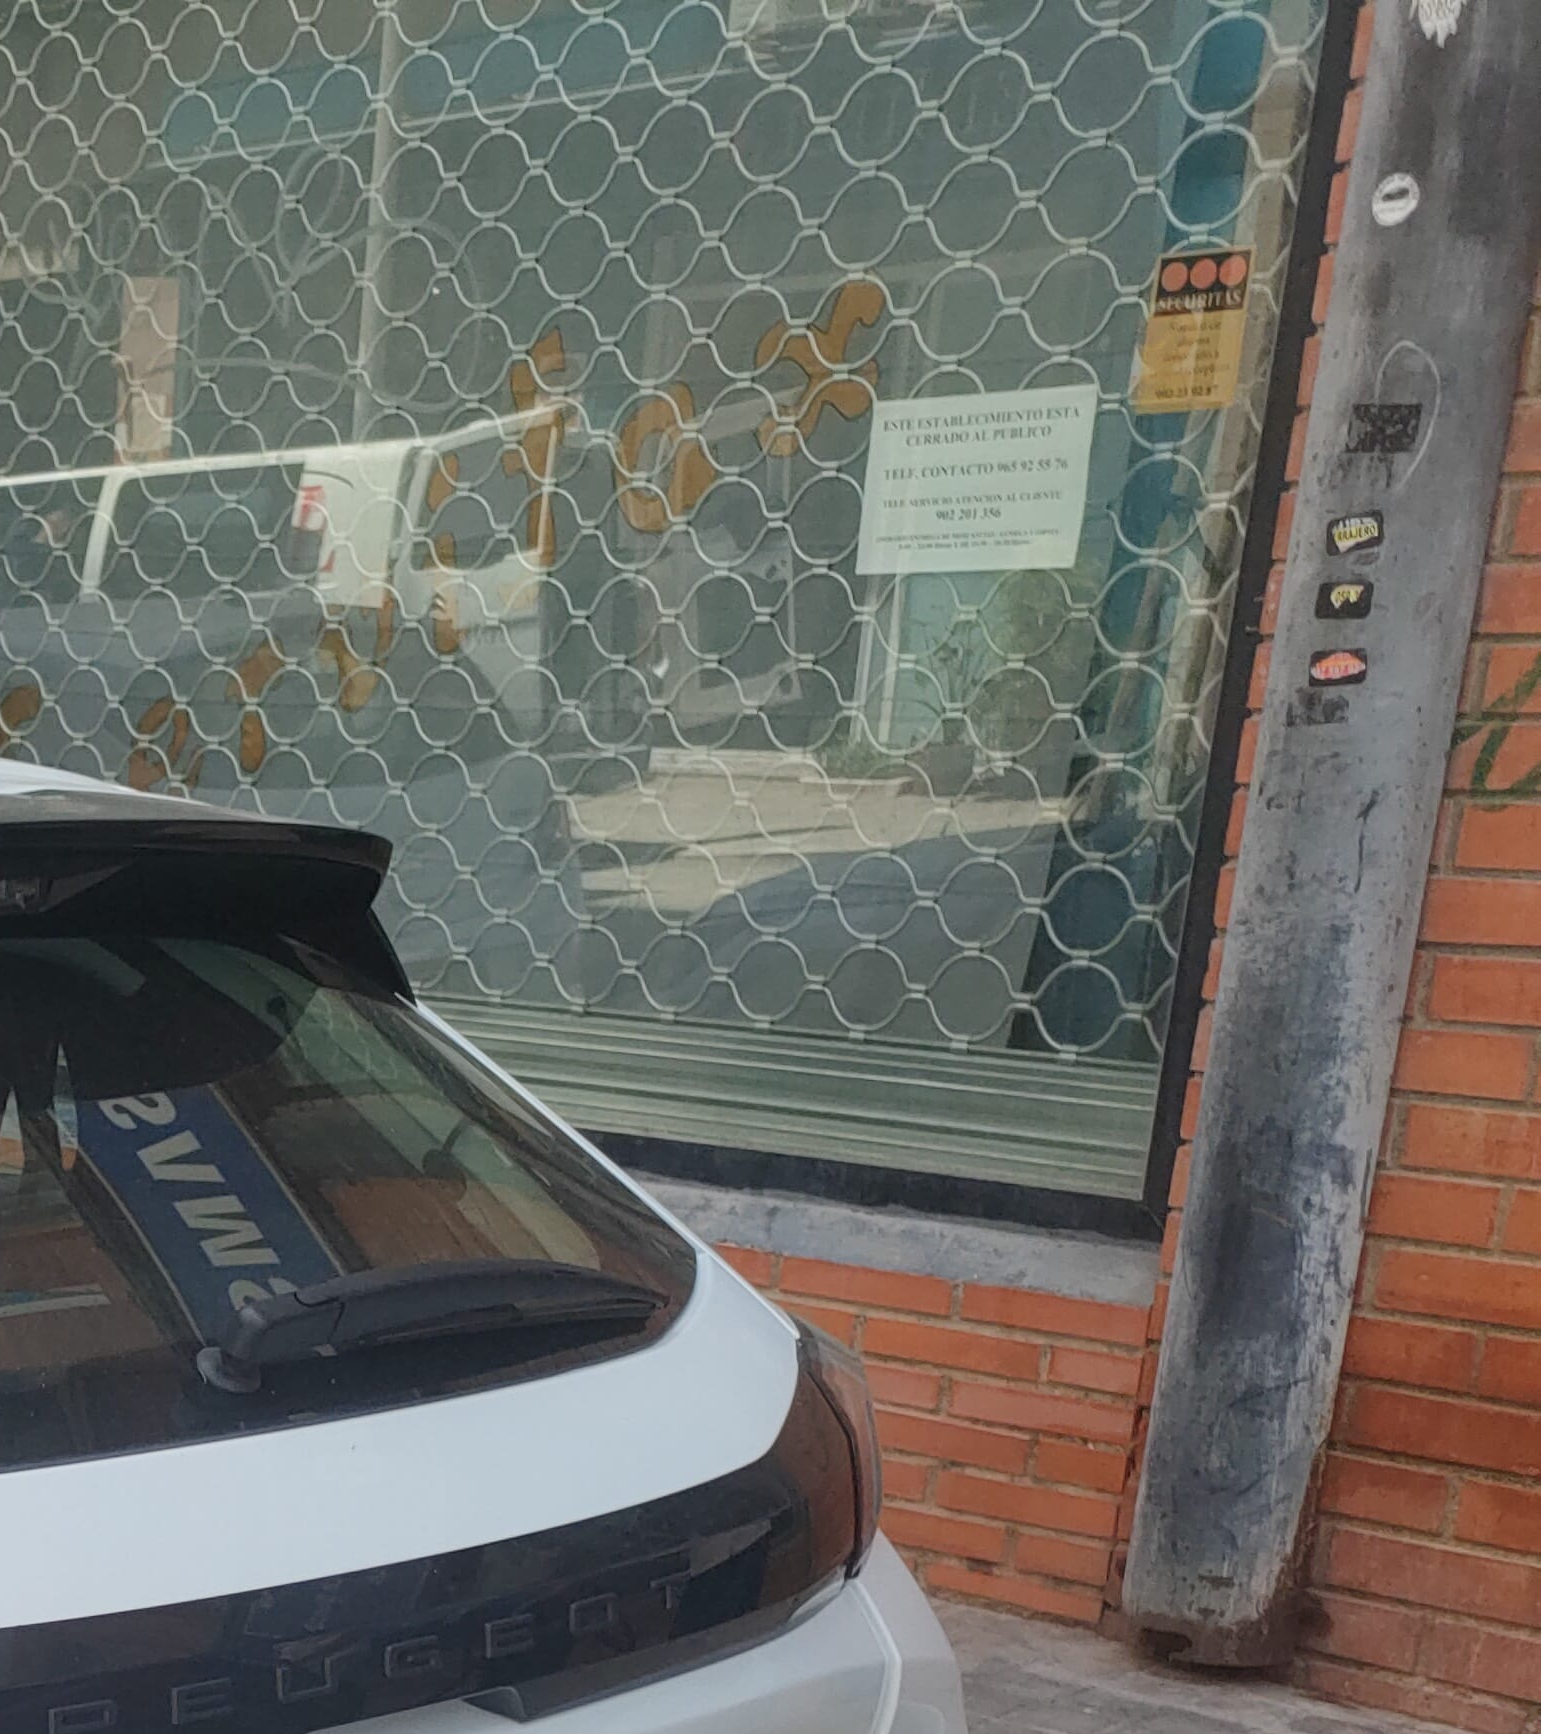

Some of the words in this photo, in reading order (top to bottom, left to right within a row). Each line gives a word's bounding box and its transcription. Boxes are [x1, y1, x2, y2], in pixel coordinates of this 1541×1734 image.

[1157, 289, 1242, 311] SECURITAS
[883, 418, 914, 432] ESTE
[917, 410, 1044, 430] ESTABLECIMIENTO
[1046, 406, 1080, 419] ESTA
[906, 431, 969, 447] CERRADO
[971, 430, 988, 442] AL
[993, 425, 1052, 441] PUBLICO
[921, 462, 994, 478] CONTACTO
